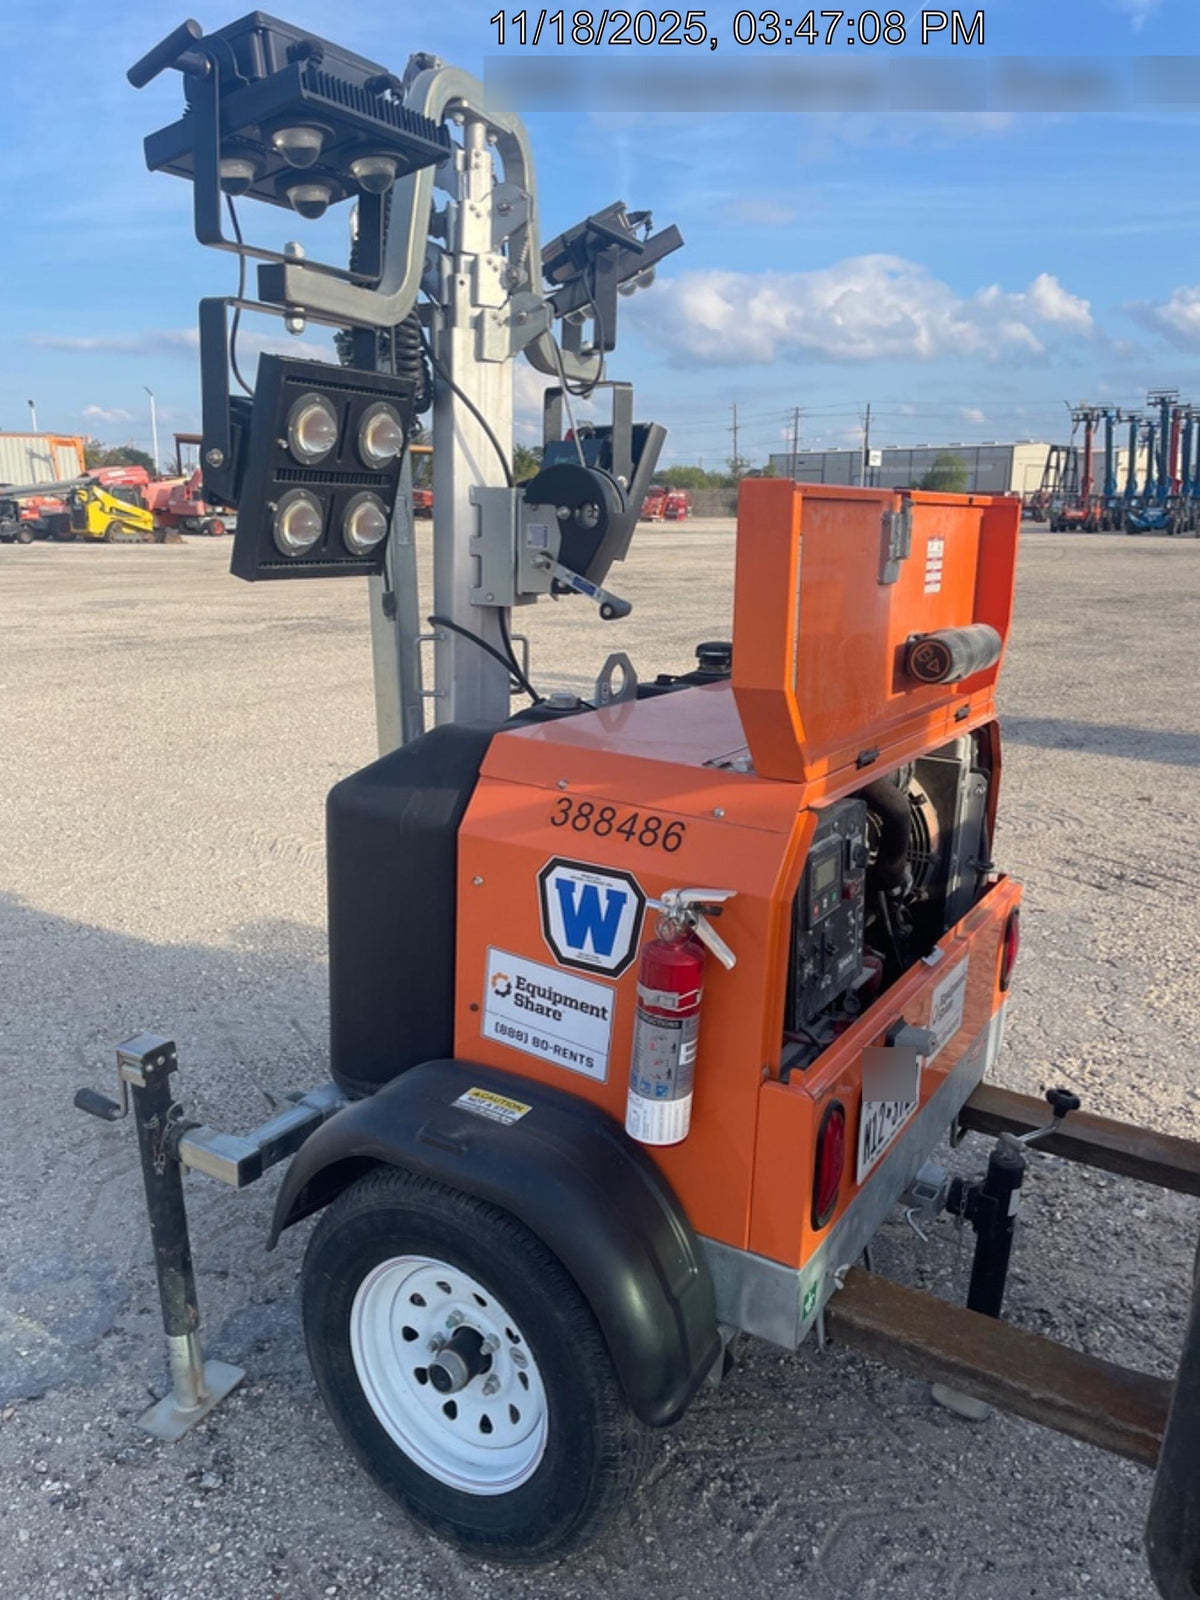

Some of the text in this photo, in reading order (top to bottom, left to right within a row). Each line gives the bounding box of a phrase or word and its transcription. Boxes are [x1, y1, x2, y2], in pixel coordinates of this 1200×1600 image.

[550, 797, 686, 852] 388486
[555, 877, 628, 957] W
[513, 993, 562, 1021] Share
[515, 975, 608, 1021] Equipment
[494, 1022, 528, 1044] (888)
